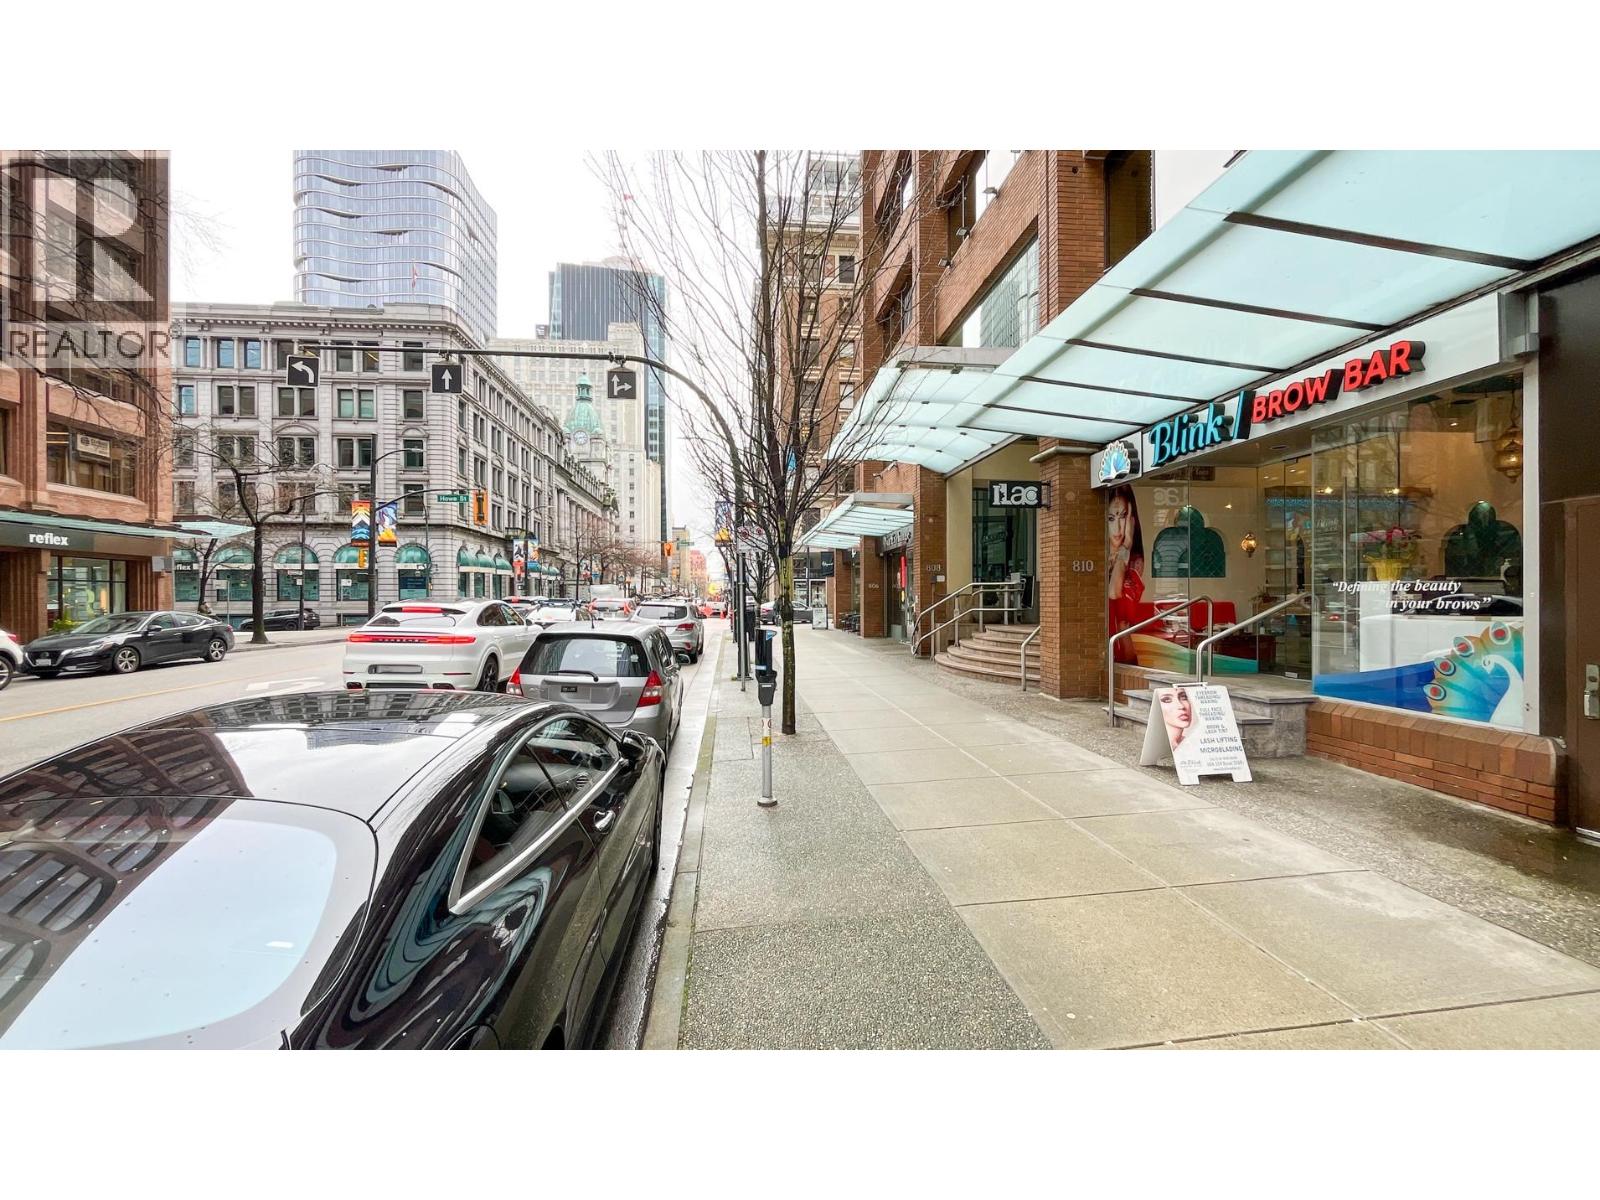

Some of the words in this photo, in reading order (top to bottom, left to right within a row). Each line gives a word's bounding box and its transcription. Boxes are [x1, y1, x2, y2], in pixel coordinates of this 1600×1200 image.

[1251, 369, 1336, 425] BROW
[1343, 340, 1418, 394] BAR
[1149, 400, 1229, 467] Blink
[29, 532, 69, 546] reflex
[1073, 560, 1094, 572] 810
[1391, 580, 1410, 592] the
[1414, 579, 1462, 595] beauty
[1385, 598, 1398, 609] in
[1400, 599, 1433, 612] your
